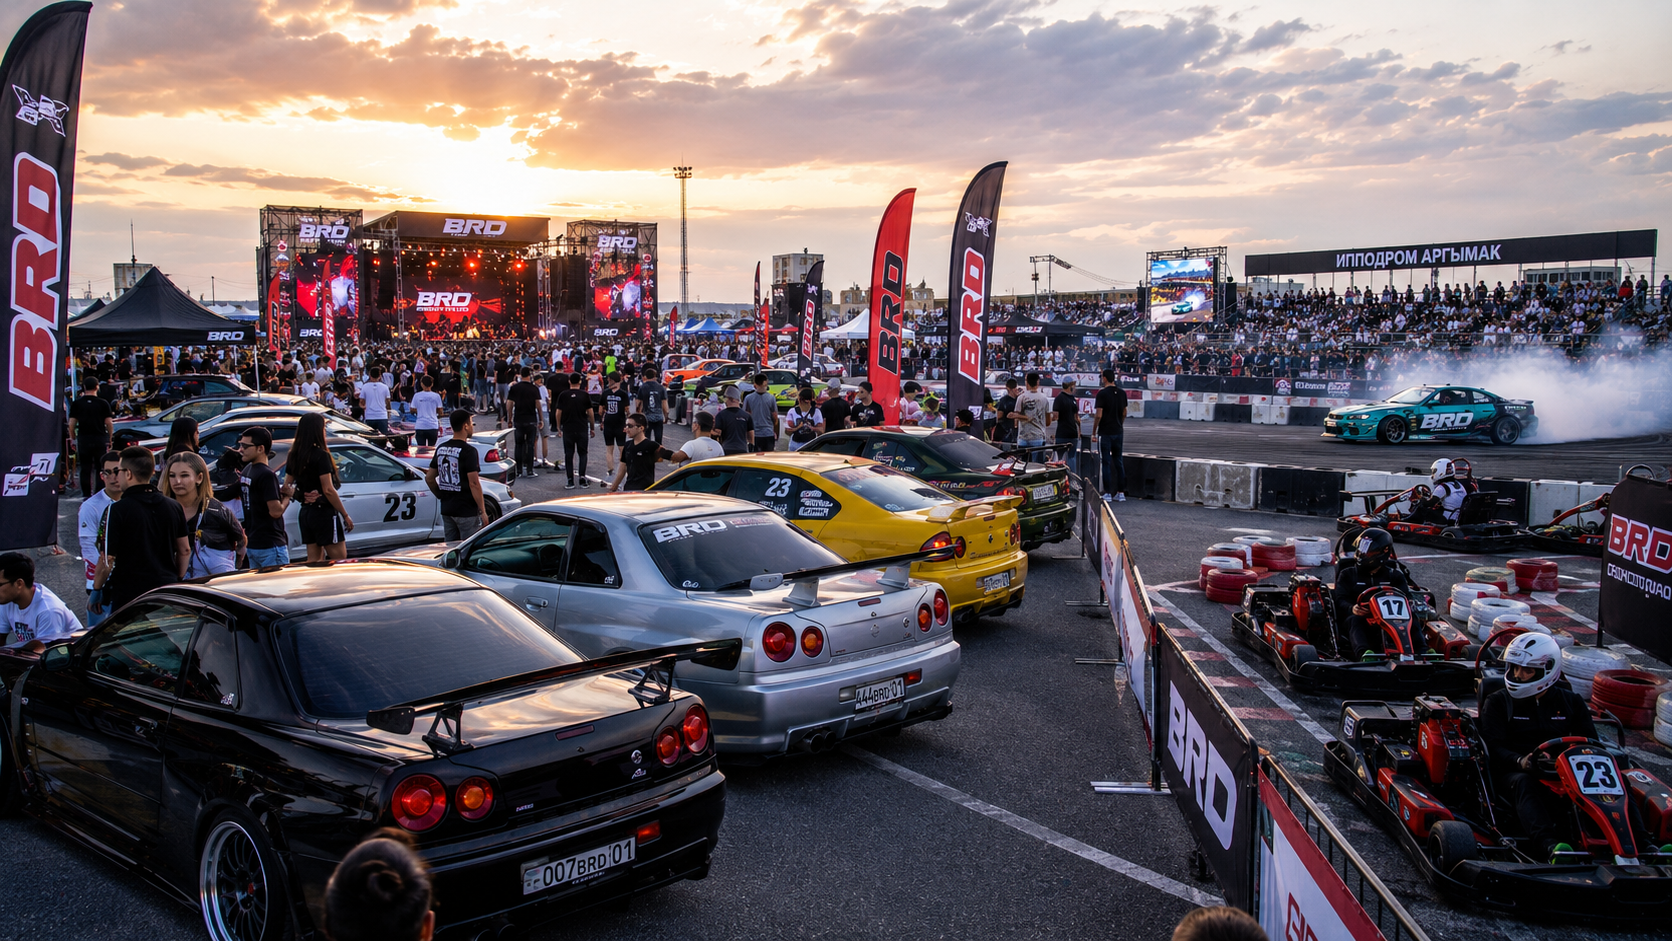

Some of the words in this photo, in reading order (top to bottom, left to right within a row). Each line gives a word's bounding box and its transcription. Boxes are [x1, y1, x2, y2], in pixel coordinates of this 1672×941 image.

[299, 223, 350, 239] BRD
[442, 218, 508, 236] BRD
[597, 235, 638, 249] BRD
[1336, 249, 1418, 269] ИППОДРОМ
[1421, 244, 1502, 264] АРГЫМАК
[9, 151, 61, 413] BRD
[416, 291, 472, 307] BRD
[878, 250, 904, 376] BRD
[958, 246, 986, 386] BRD
[207, 331, 245, 341] BRD
[1420, 412, 1474, 429] BRD
[764, 477, 792, 498] 23
[383, 492, 416, 523] 23
[652, 519, 727, 543] BRD
[1607, 512, 1672, 575] BRD
[1381, 599, 1404, 616] 17
[892, 679, 904, 697] 01
[1167, 679, 1238, 851] BRD
[1575, 761, 1618, 789] 23
[542, 854, 607, 887] 007BRD
[612, 840, 632, 865] 01
